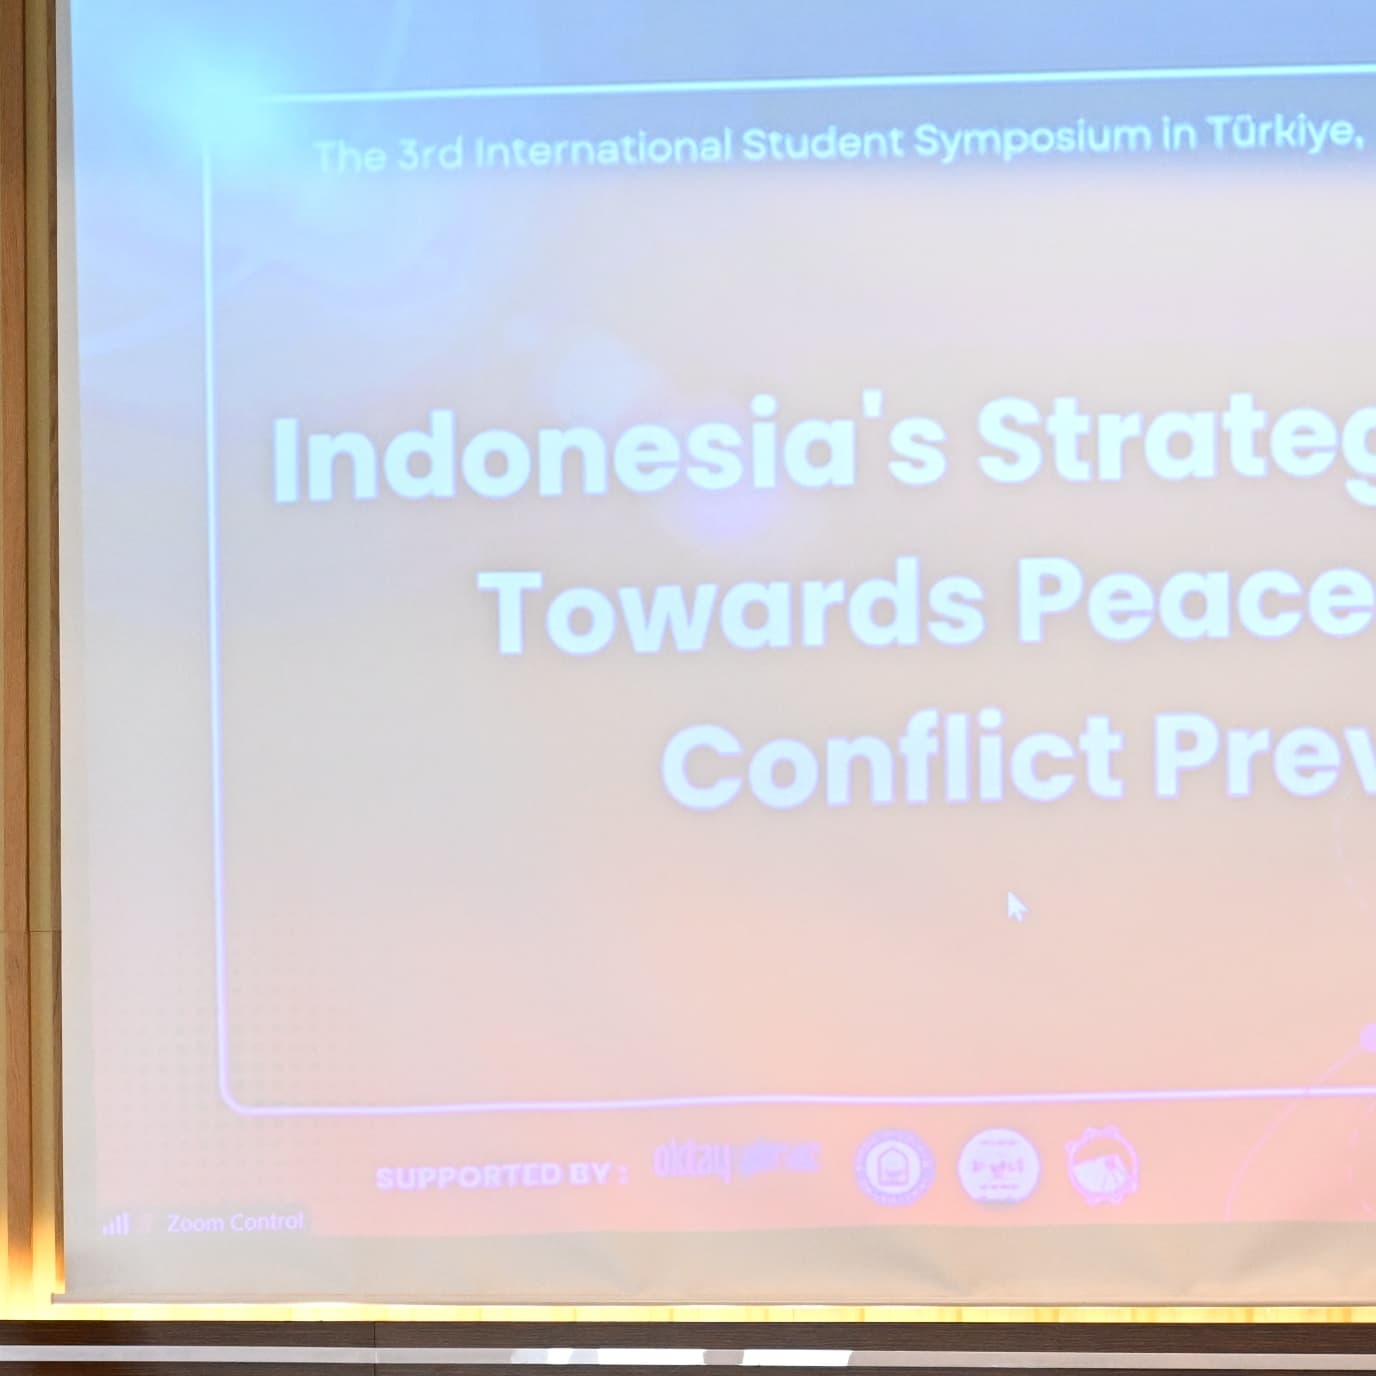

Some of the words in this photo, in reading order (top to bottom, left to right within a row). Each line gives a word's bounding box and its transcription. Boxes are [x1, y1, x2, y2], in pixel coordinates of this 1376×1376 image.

[314, 141, 386, 172] The
[400, 136, 462, 170] 3rd
[477, 128, 732, 166] International
[743, 126, 904, 160] Student
[915, 118, 1151, 163] Symposium
[1162, 116, 1196, 149] in
[1206, 113, 1364, 154] Türkiye,
[275, 389, 946, 502] Indonesia's
[478, 557, 984, 654] Towards
[1019, 558, 1375, 642] Peace
[662, 708, 1123, 808] Conflict
[376, 1163, 562, 1190] SUPPORTED
[570, 1163, 611, 1184] BY
[168, 1215, 224, 1232] Zoom
[230, 1212, 303, 1231] Control
